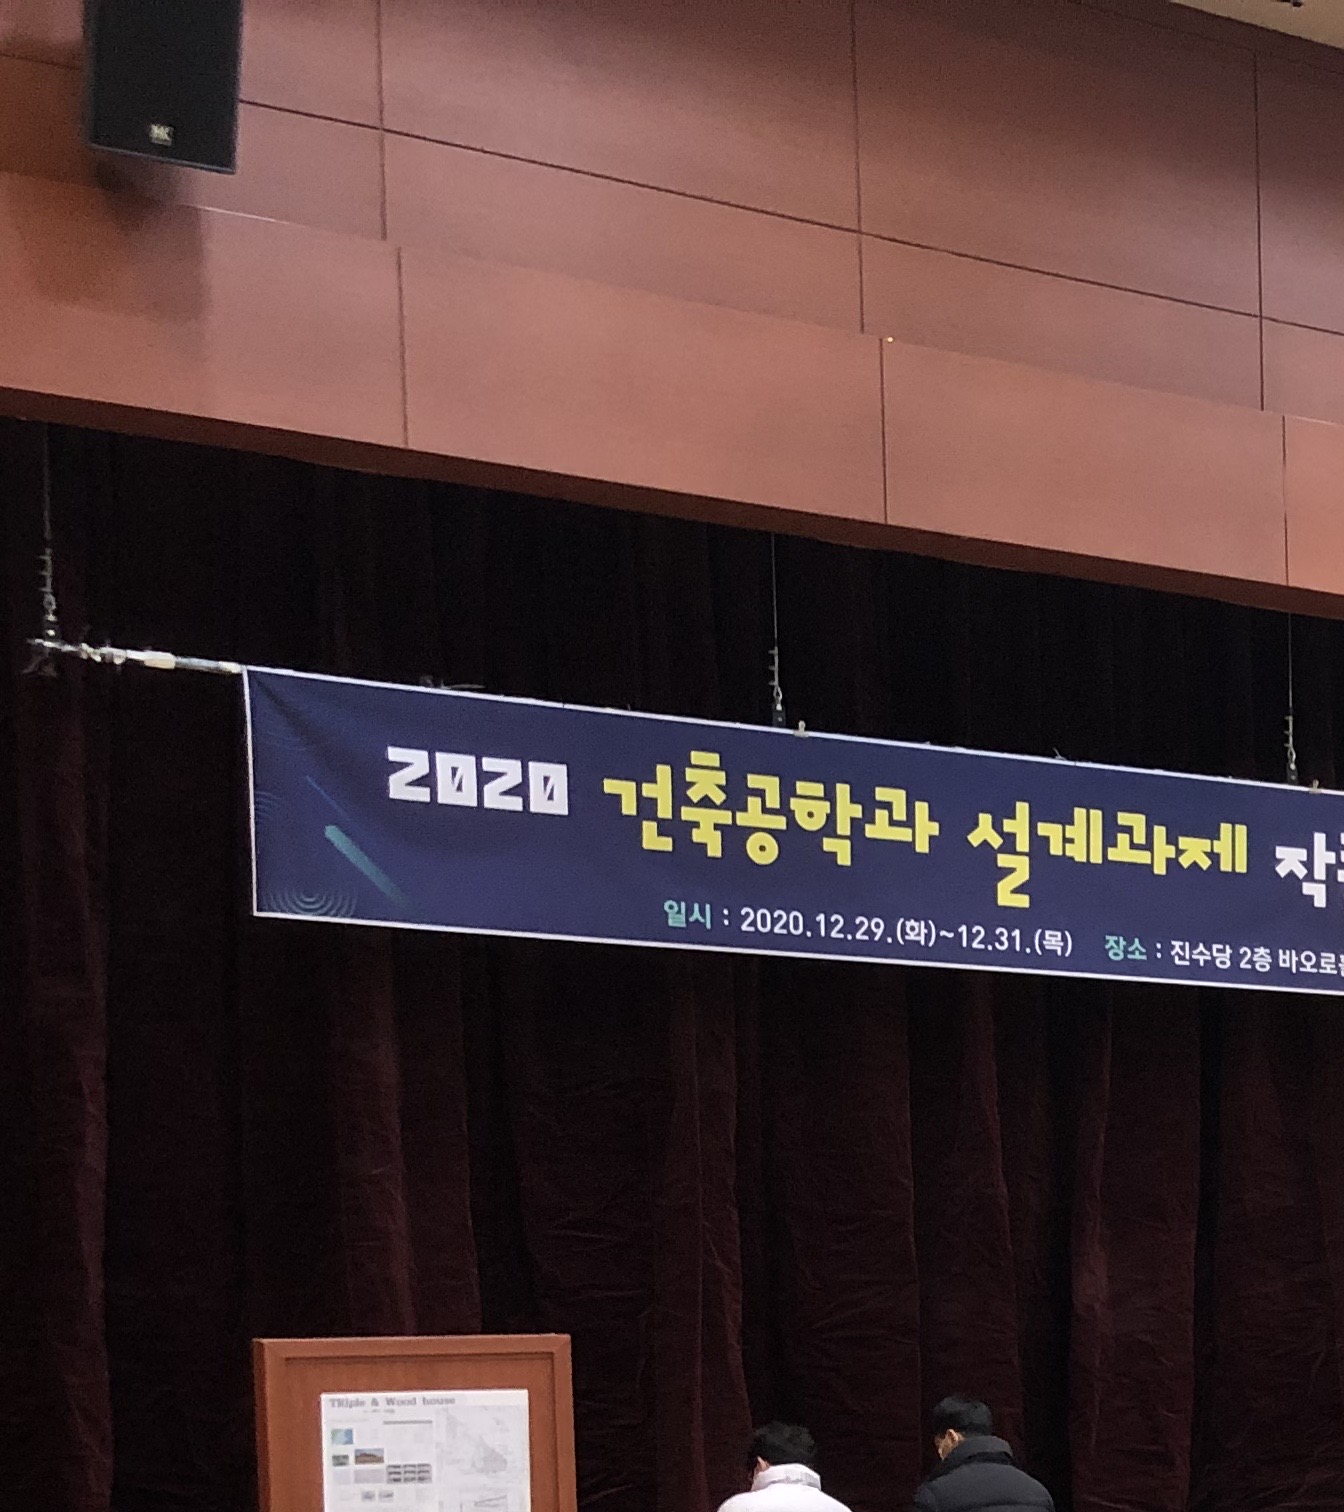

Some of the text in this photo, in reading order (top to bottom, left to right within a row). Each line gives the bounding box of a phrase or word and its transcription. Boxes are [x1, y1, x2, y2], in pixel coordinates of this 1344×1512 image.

[387, 745, 569, 816] 2020
[602, 750, 940, 867] 건축공학과
[966, 800, 1248, 909] 설계과제
[663, 899, 712, 930] 일시
[739, 907, 1073, 959] 2020.12.29.(화)~12.31.(목)
[1104, 934, 1148, 962] 장소
[1170, 939, 1232, 970] 진수당
[1238, 945, 1273, 973] 2층
